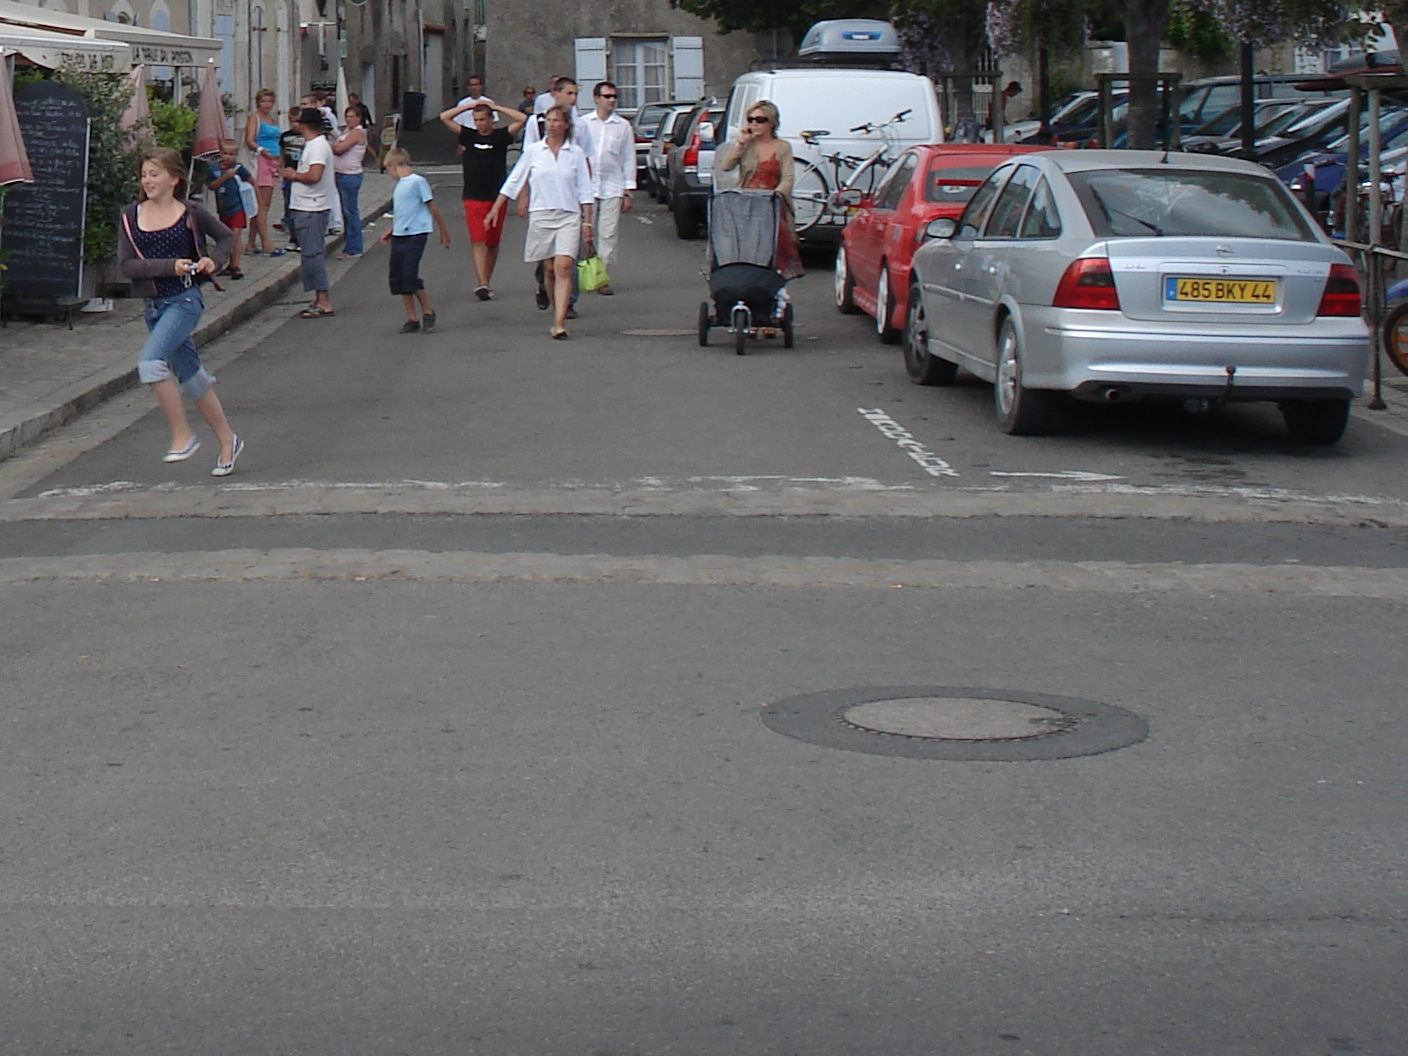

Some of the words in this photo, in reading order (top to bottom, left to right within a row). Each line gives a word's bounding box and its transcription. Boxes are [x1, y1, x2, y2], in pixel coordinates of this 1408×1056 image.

[1179, 281, 1212, 299] 485
[1215, 282, 1246, 300] BKY
[1251, 284, 1271, 301] 44
